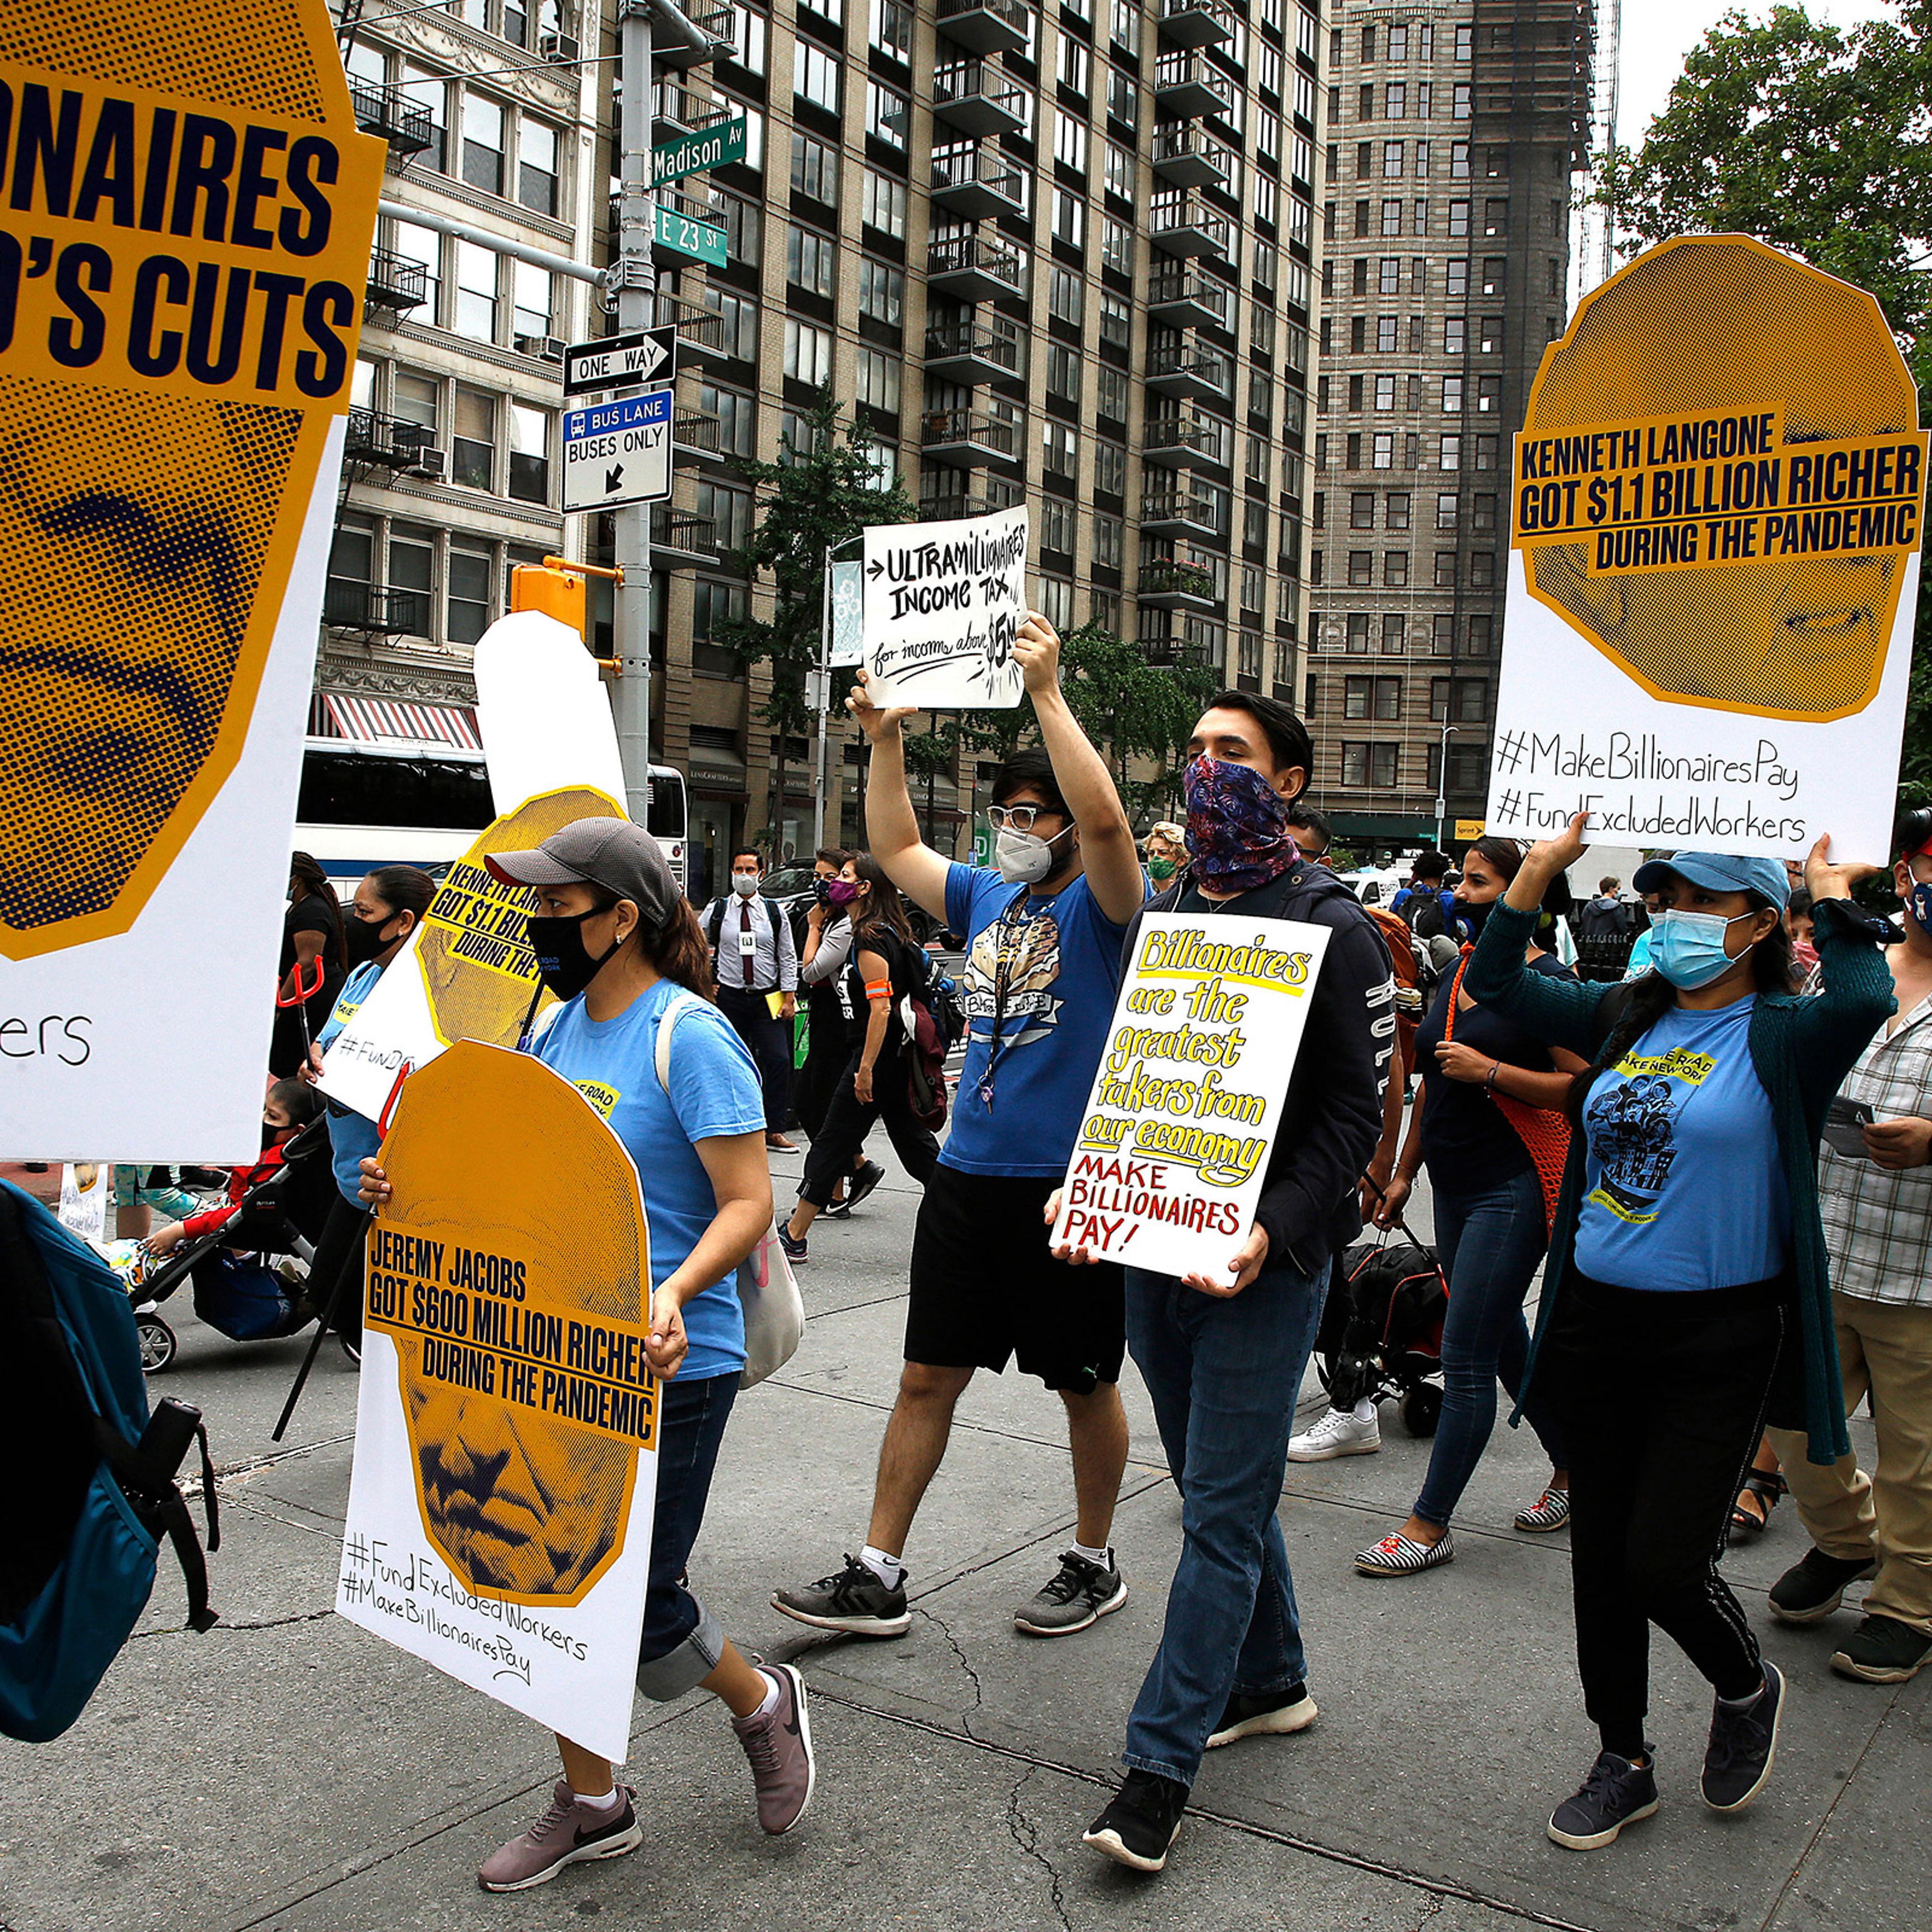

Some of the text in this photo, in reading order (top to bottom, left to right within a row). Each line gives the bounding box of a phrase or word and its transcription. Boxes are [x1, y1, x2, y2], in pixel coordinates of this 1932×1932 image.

[0, 78, 340, 257] NAIRES
[654, 126, 743, 181] Madison Av
[662, 212, 717, 252] E 23 St
[127, 254, 355, 398] CUTS
[579, 346, 658, 378] ONE WAY
[592, 400, 663, 430] BUS LANE
[569, 426, 664, 463] BUSES ONLY
[1521, 413, 1775, 480] KENNETH LANGONE
[1519, 444, 1920, 530] GOT $1.1 BILLION RICHER
[1596, 503, 1916, 571] DURING THE PANDEMIC
[979, 573, 1009, 606] TAX
[870, 642, 899, 677] for
[901, 639, 953, 660] income
[956, 621, 988, 651] above
[1496, 730, 1798, 800] #MakeBillionairesPay
[1496, 788, 1805, 842] #FundExcludedWorkers
[432, 889, 533, 946] GOT $1.1 BILL
[453, 931, 535, 978] DURING THE
[1137, 930, 1312, 985] Billionaires
[1127, 978, 1249, 1024] are the
[1107, 1024, 1246, 1074] greatest
[584, 1085, 614, 1106] ROAD
[1096, 1061, 1266, 1127] takers from
[1074, 1155, 1169, 1189] MAKE
[1084, 1114, 1267, 1187] our economy
[1063, 1211, 1141, 1253] PAY!
[371, 1229, 527, 1302] JEREMY JACOBS
[369, 1271, 409, 1321] GOT
[413, 1281, 468, 1337] $600
[473, 1298, 563, 1363] MILLION
[423, 1338, 653, 1441] DURING THE PANDEMIC
[347, 1532, 589, 1661] #FundExcludedWorkers
[342, 1571, 531, 1686] #MakeBillionairesPay
